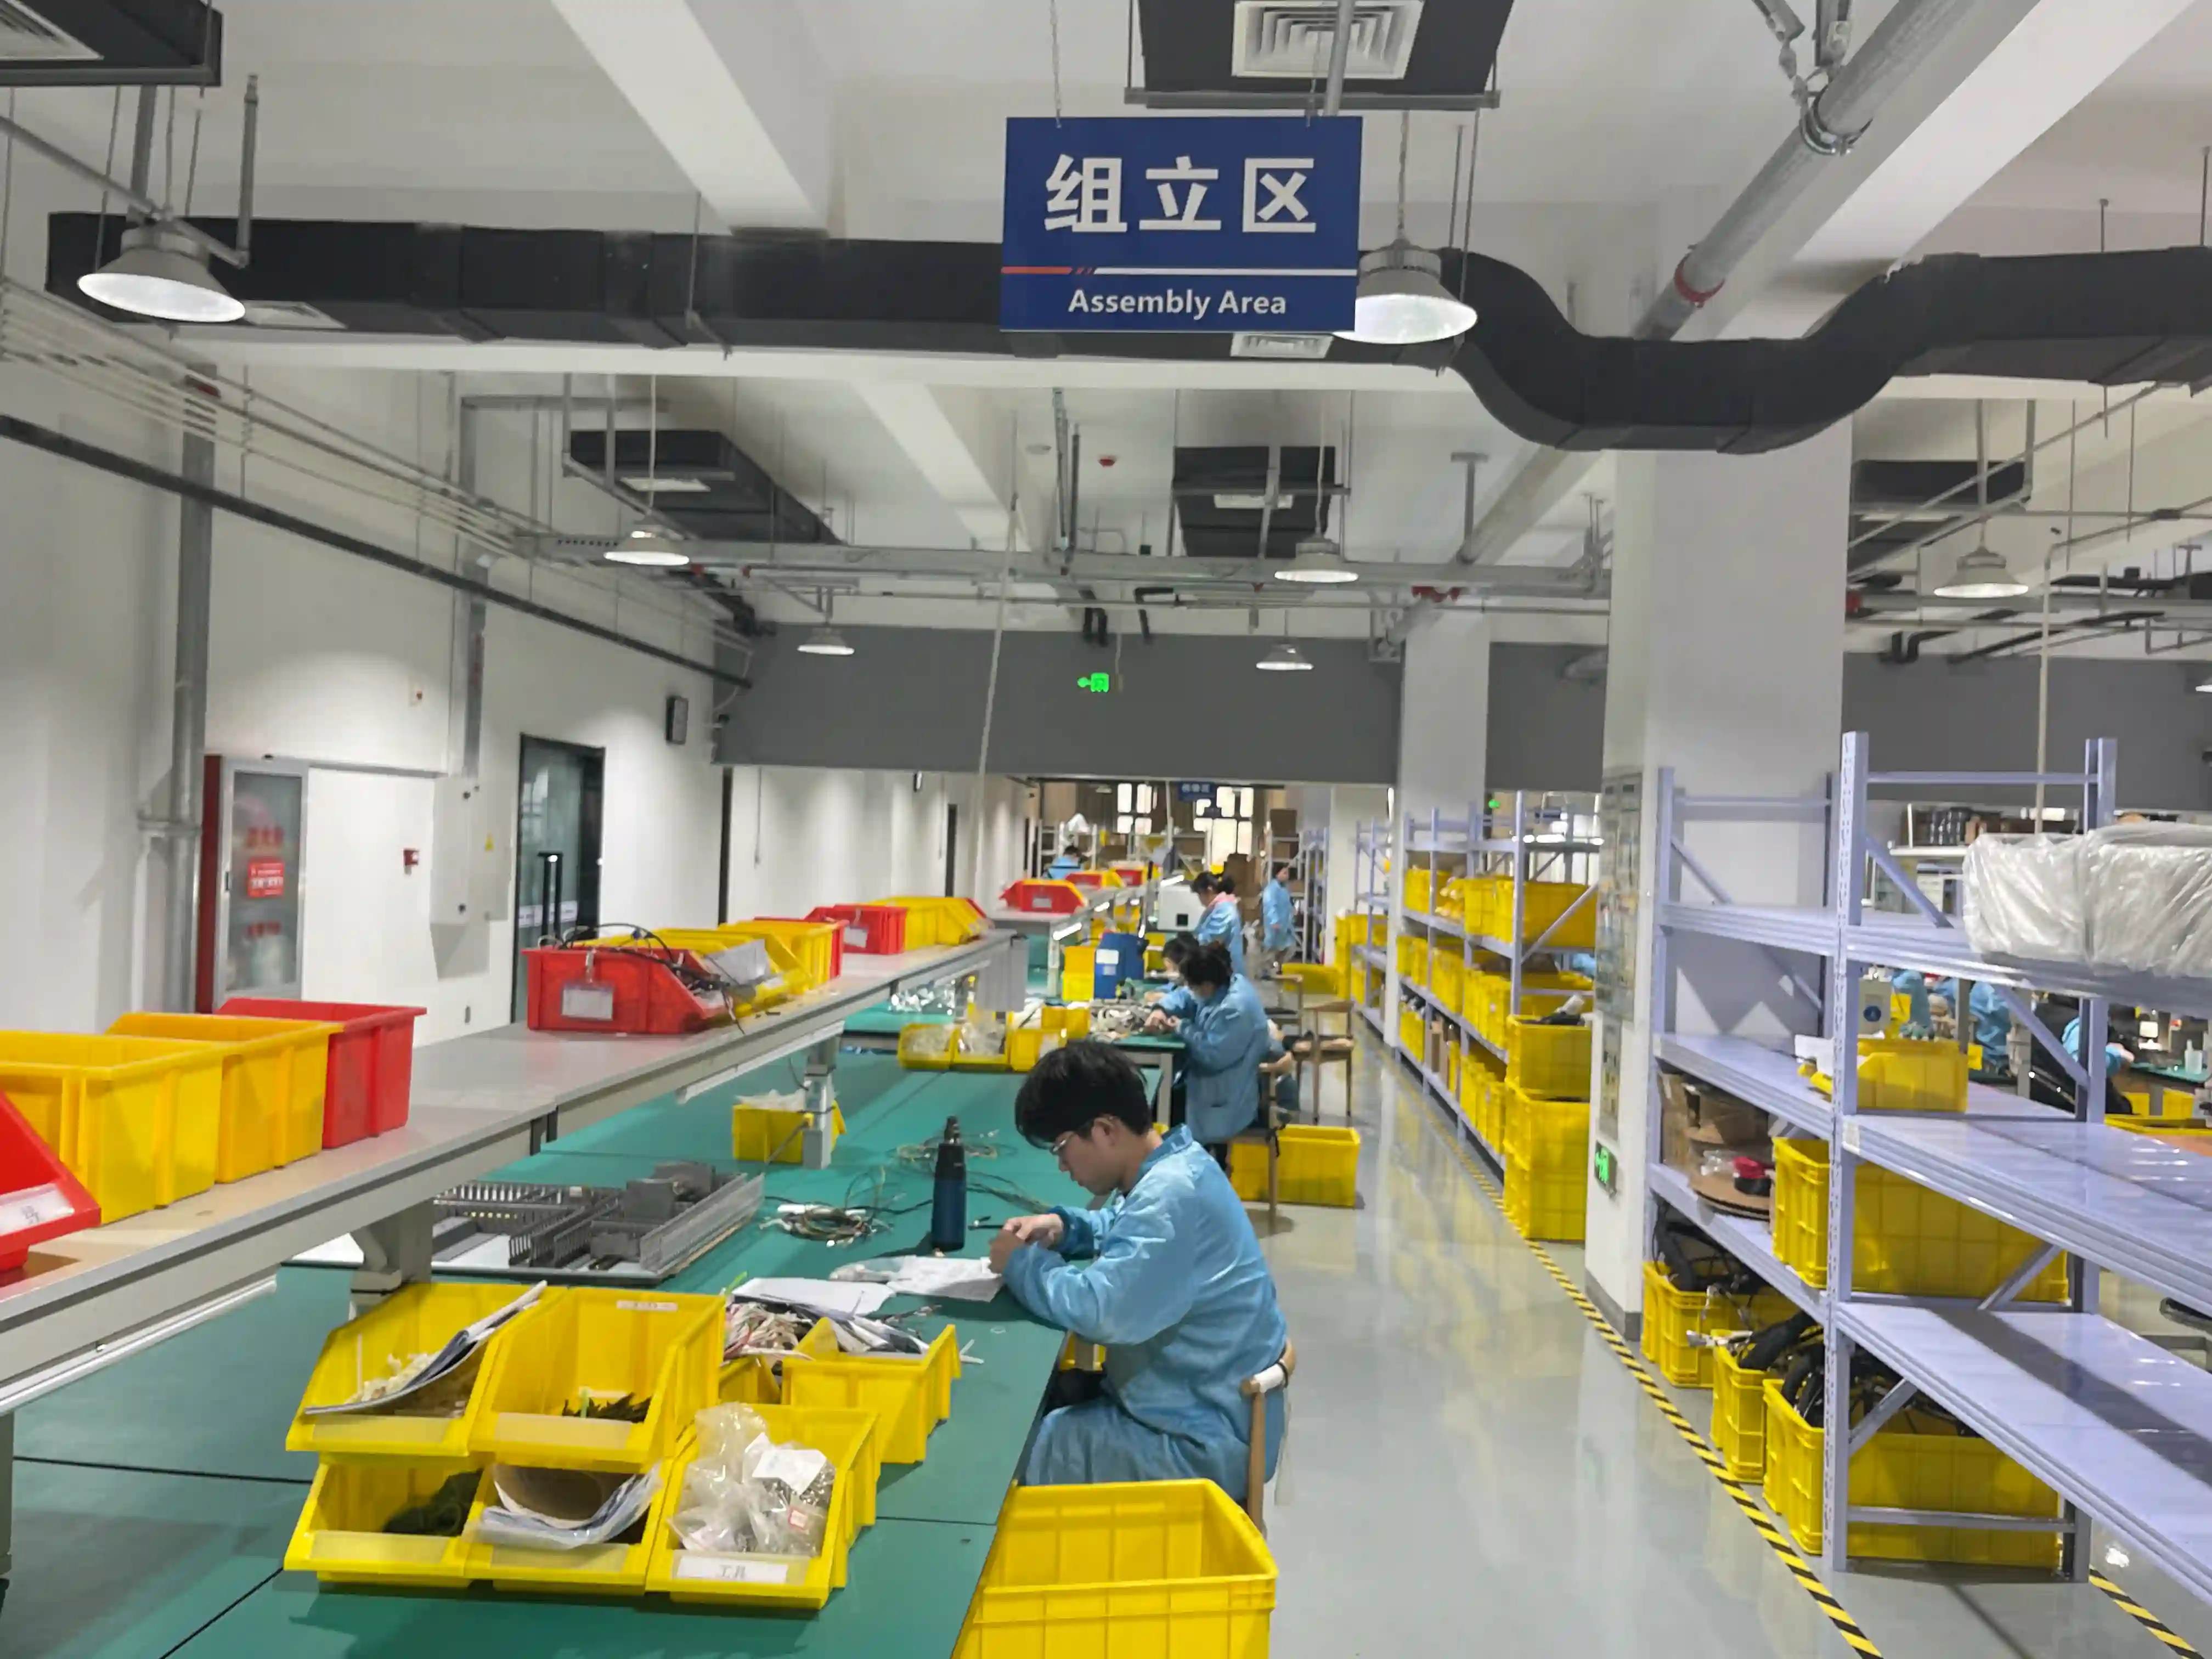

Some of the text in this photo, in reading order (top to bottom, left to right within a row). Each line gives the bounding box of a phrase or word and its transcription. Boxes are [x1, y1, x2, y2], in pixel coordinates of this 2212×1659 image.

[1044, 154, 1316, 233] 组立区
[1068, 289, 1286, 320] Assembly Area
